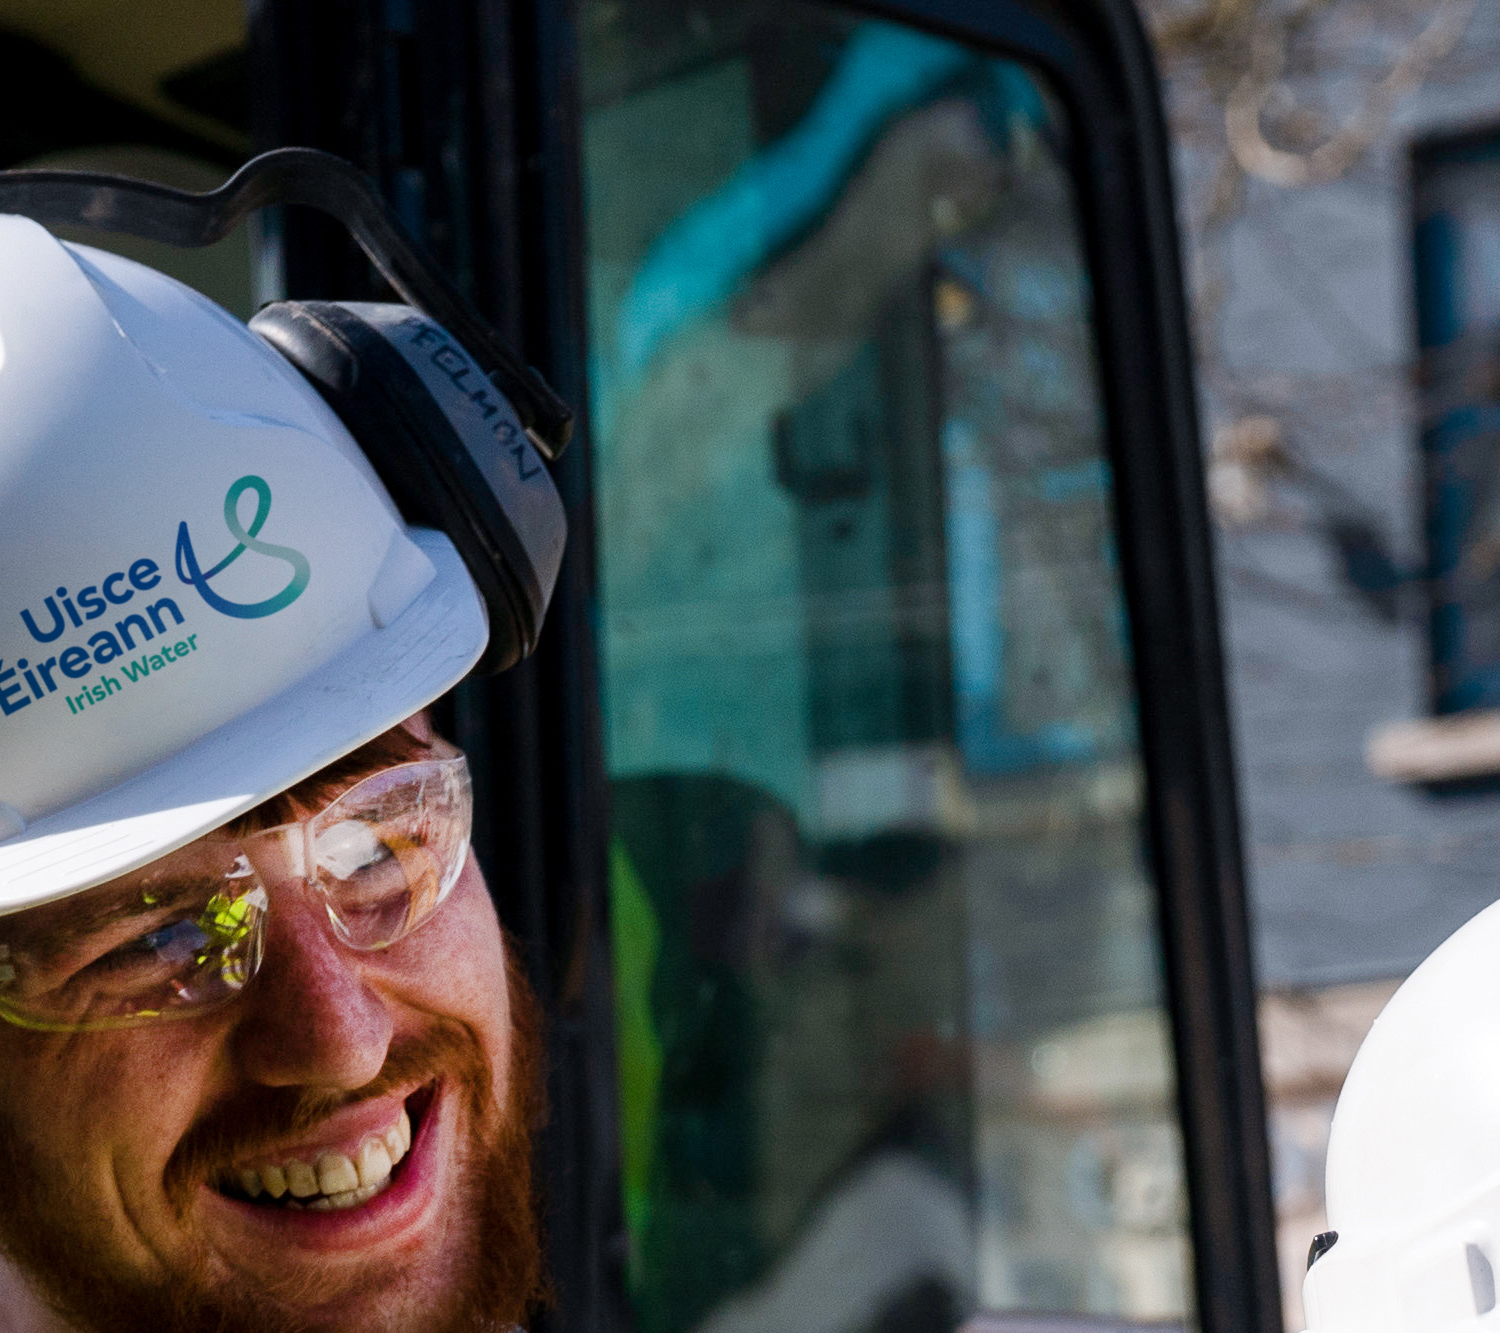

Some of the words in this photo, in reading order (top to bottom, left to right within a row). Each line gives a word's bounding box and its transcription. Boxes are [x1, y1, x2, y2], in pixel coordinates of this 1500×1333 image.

[19, 557, 163, 644] Uisce
[64, 674, 123, 716] Irish
[120, 632, 198, 684] Water
